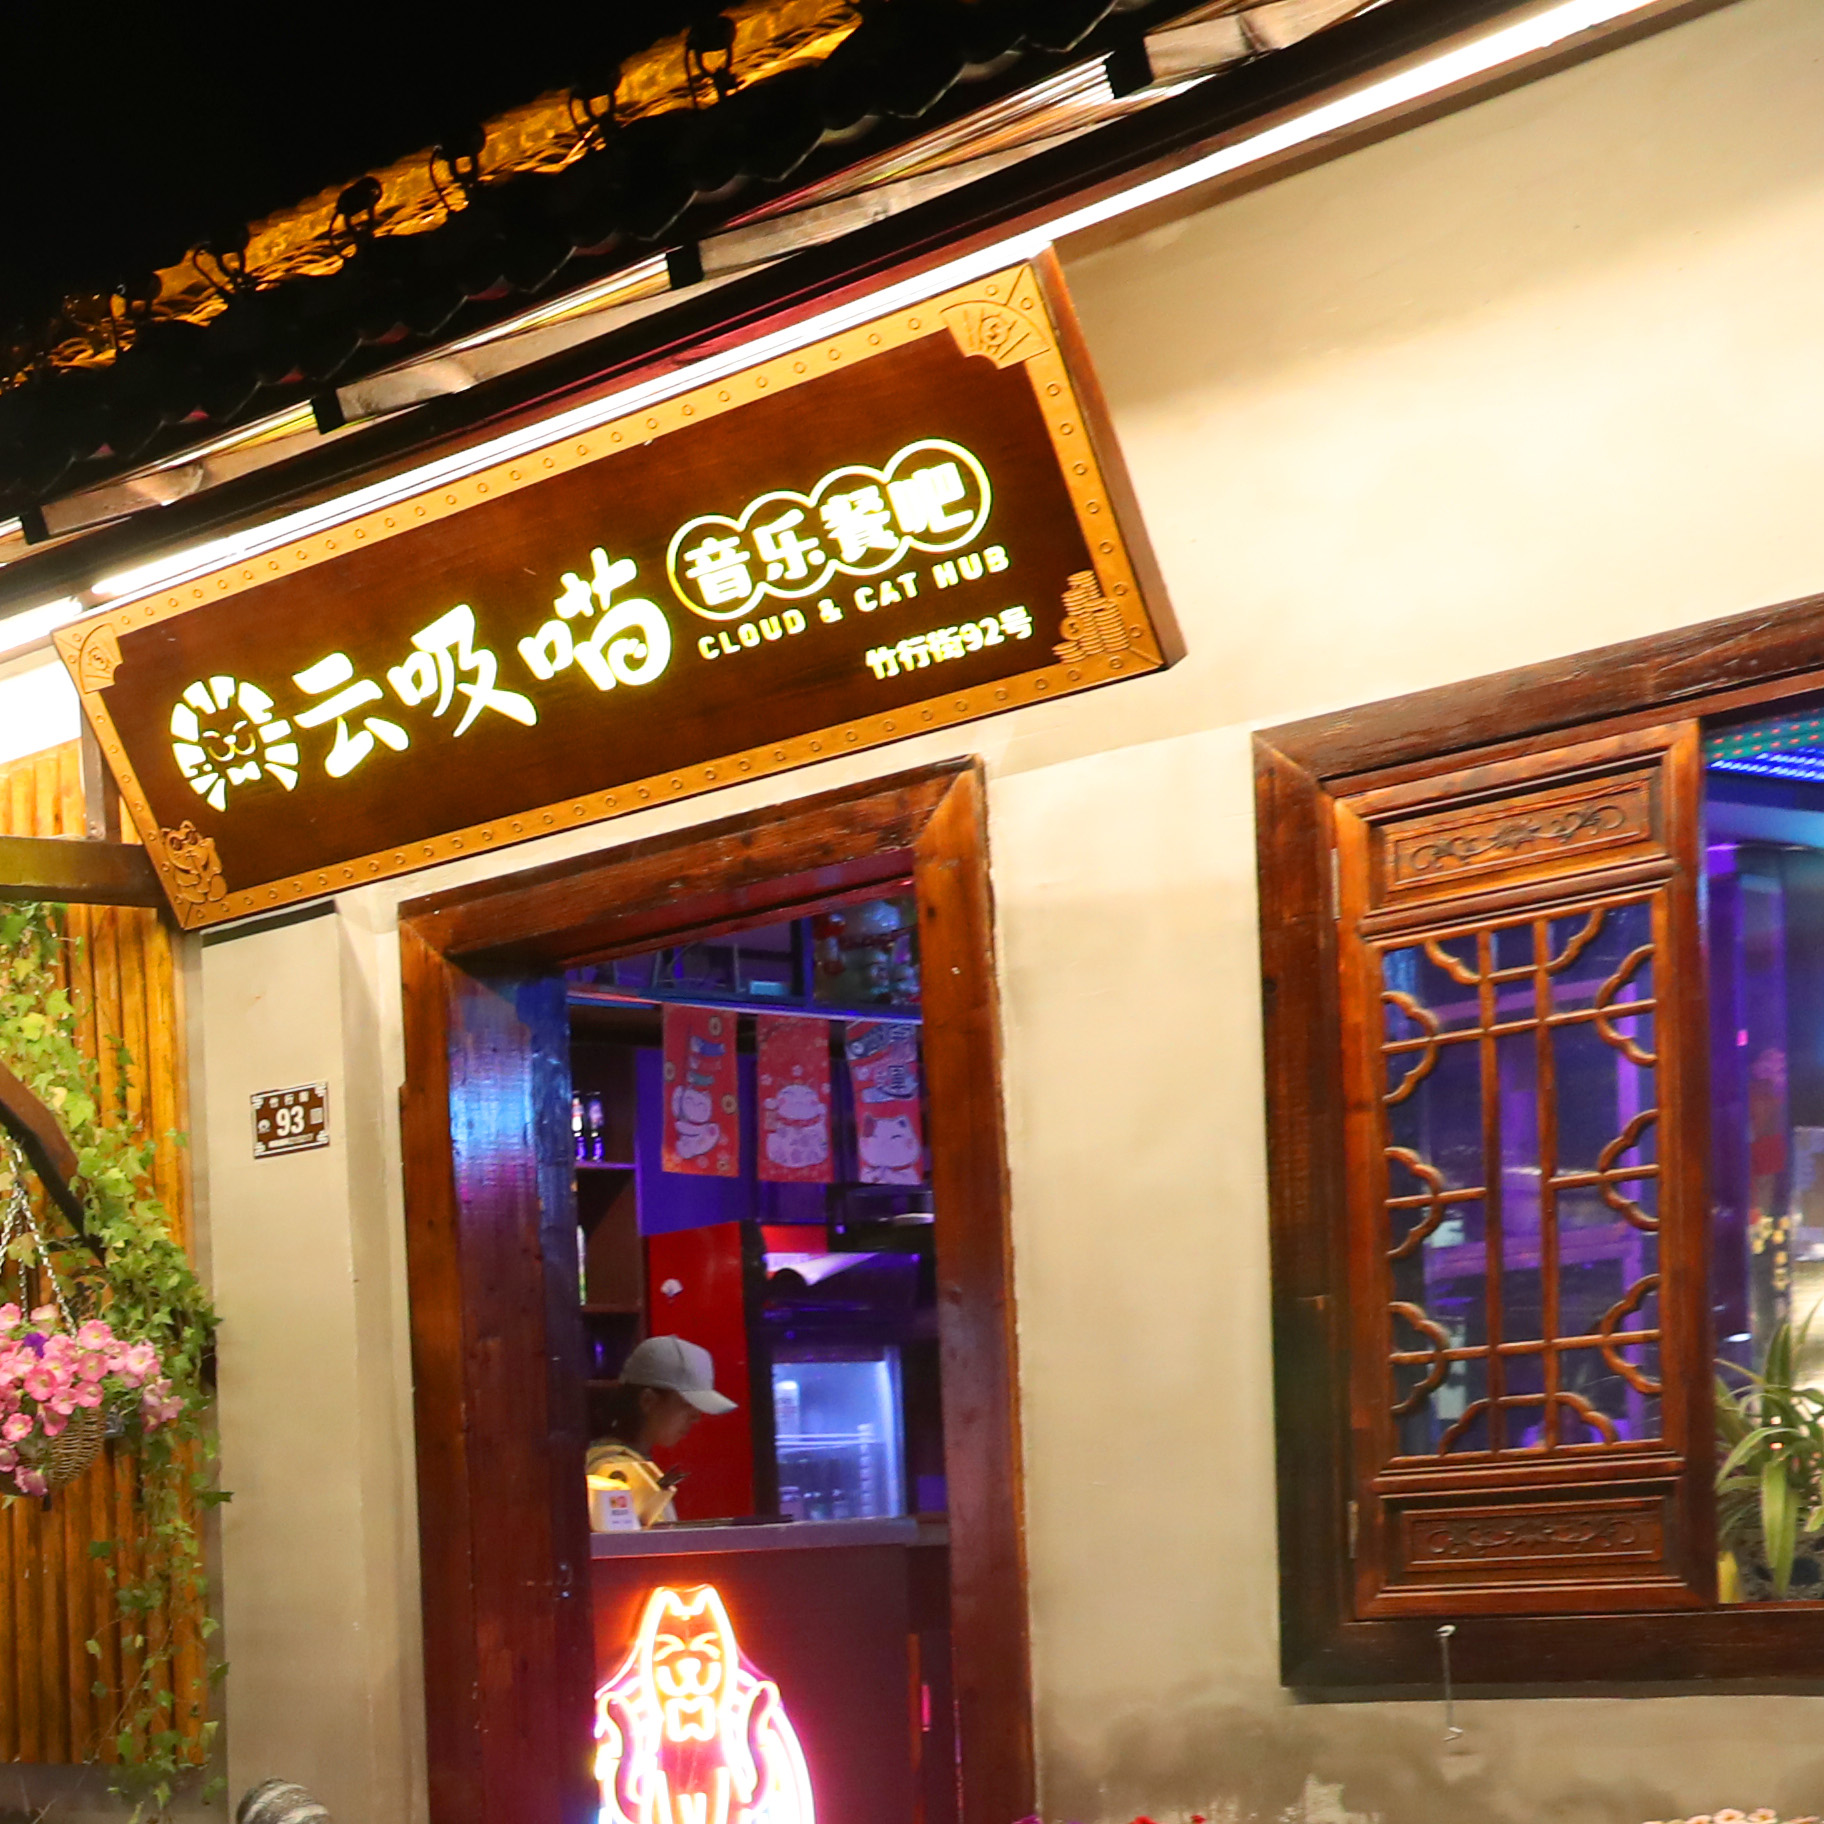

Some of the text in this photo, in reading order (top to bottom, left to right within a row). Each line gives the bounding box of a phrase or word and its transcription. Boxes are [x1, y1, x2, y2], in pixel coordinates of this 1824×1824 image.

[684, 459, 975, 607] 音乐餐吧
[697, 544, 1011, 661] CLOUD & CAT HUB
[865, 604, 1035, 681] 竹行街92号
[292, 544, 673, 779] 云吸喵
[275, 1105, 305, 1137] 93
